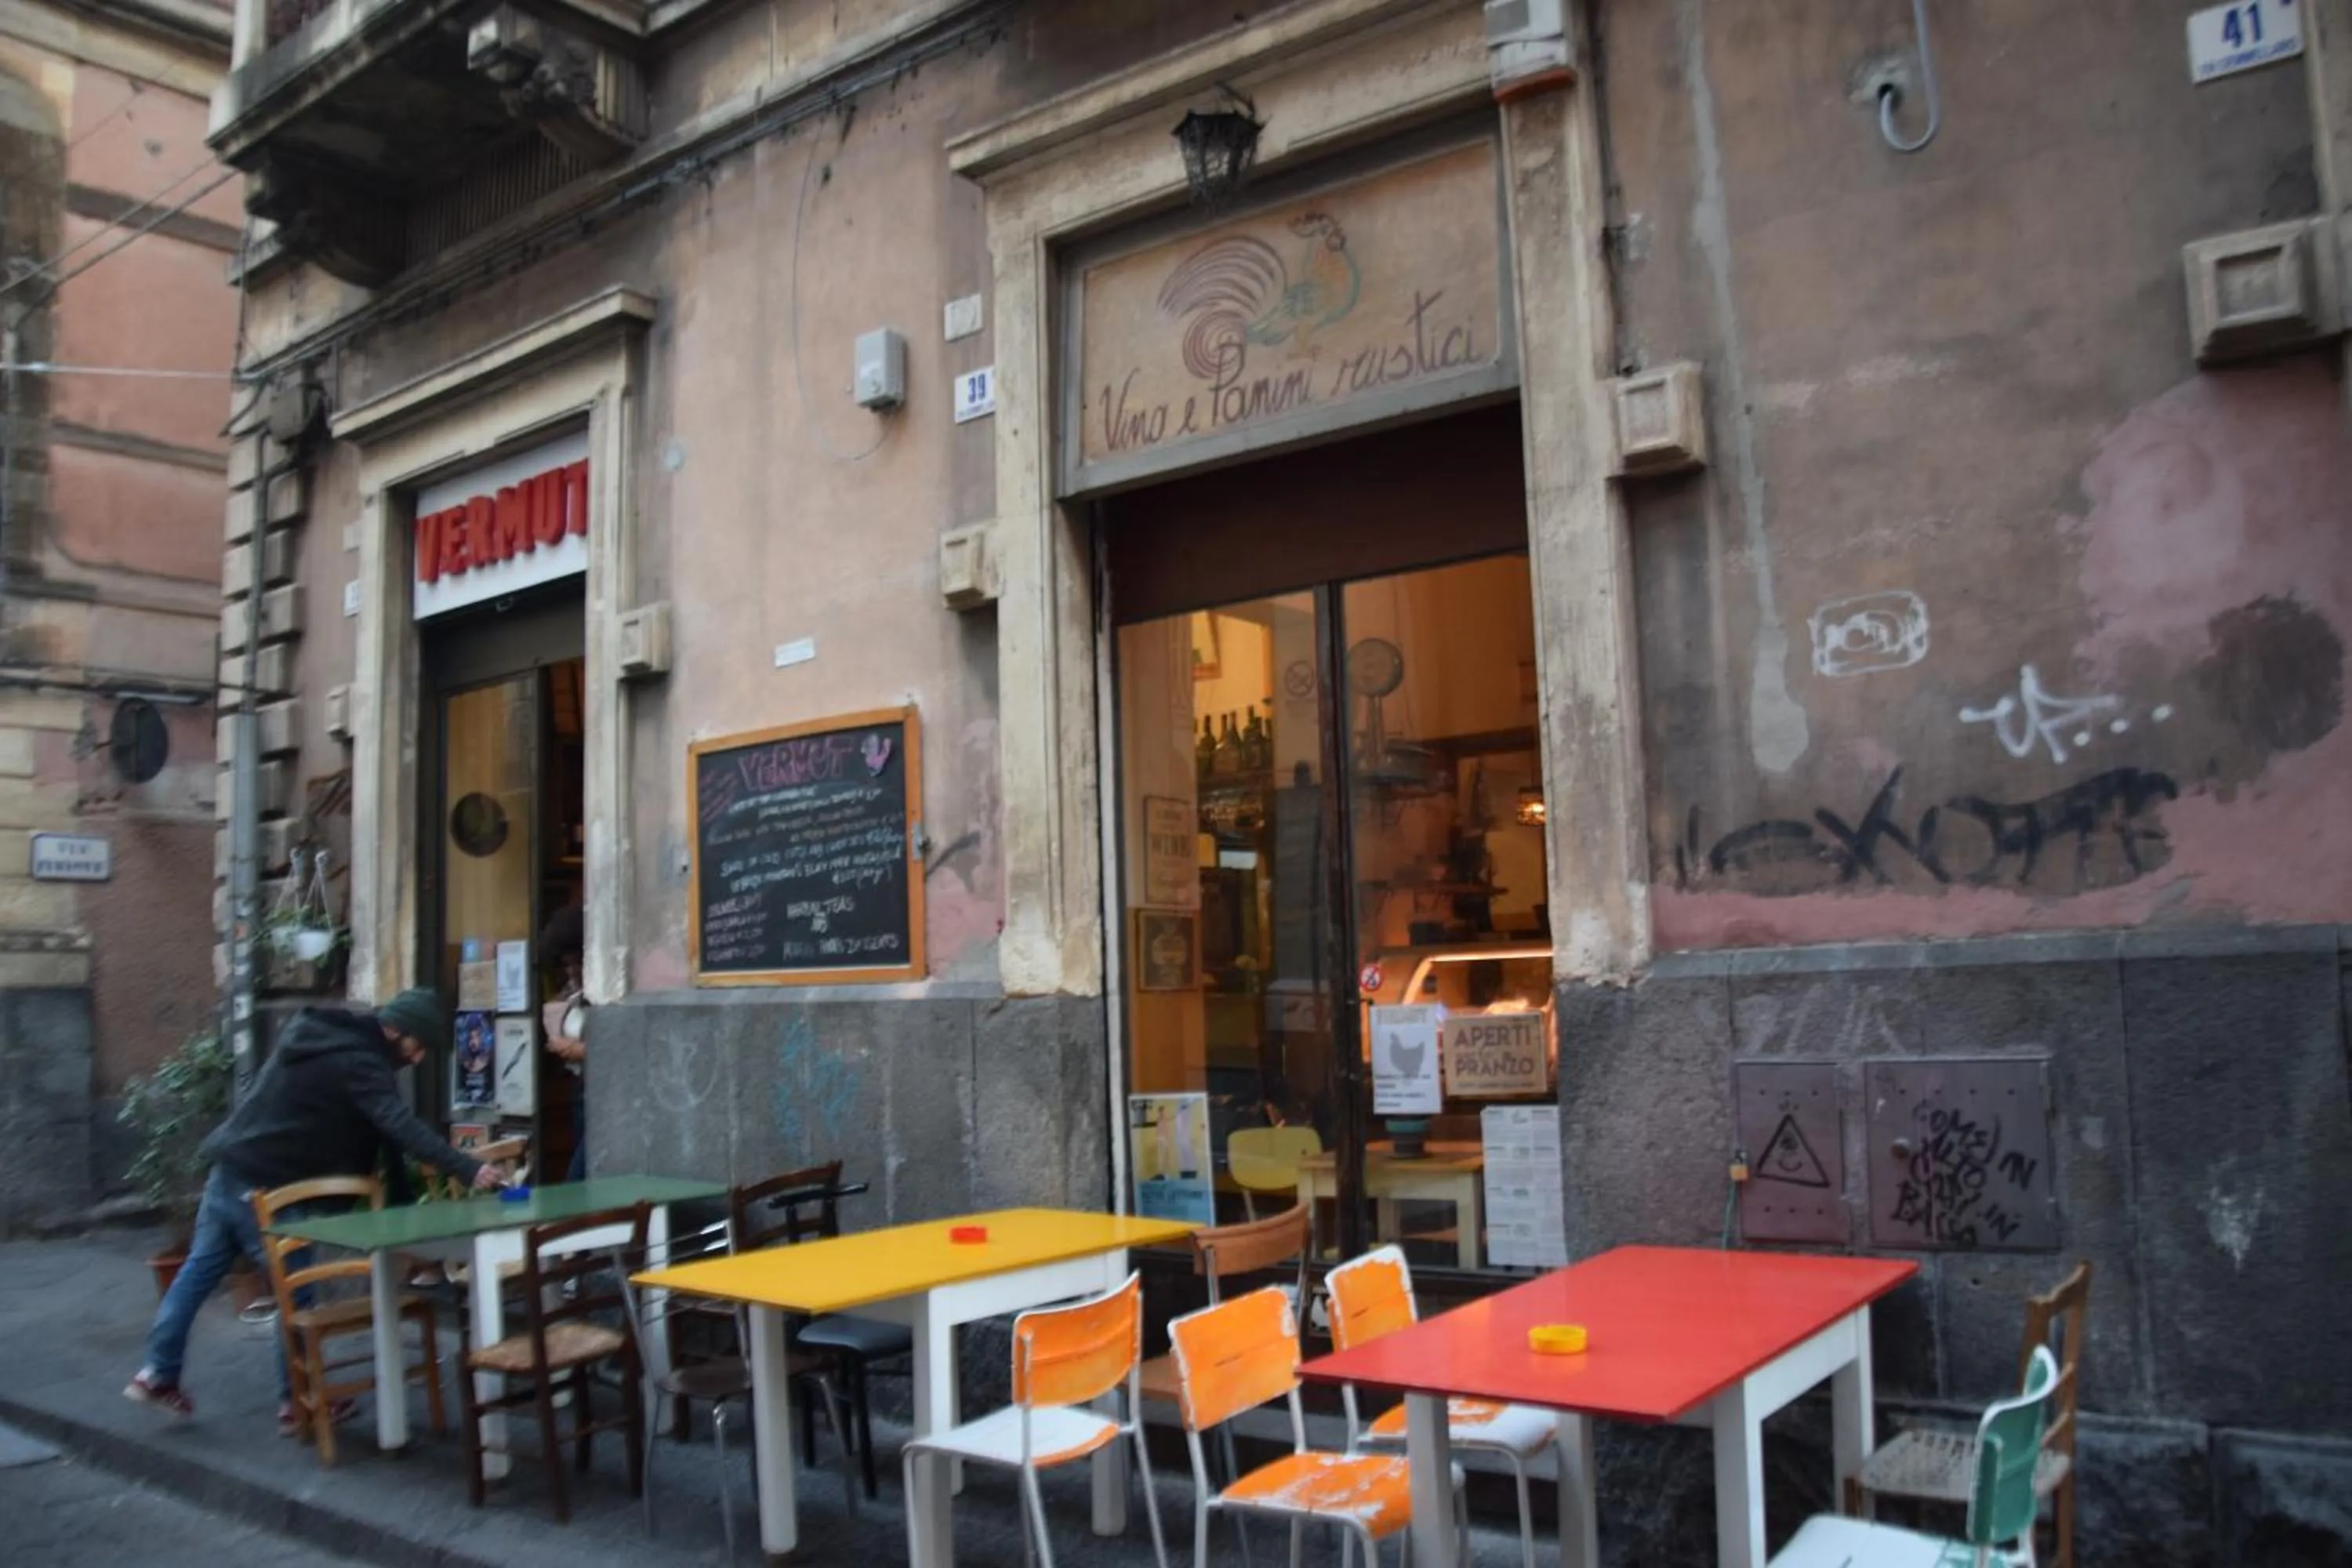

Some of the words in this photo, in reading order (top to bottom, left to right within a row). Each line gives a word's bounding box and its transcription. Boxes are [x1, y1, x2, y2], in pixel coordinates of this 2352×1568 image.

[2222, 1, 2263, 48] 41
[968, 373, 985, 403] 39
[1099, 368, 1169, 452] Vino
[1208, 342, 1312, 428] Panini
[416, 457, 589, 582] VERMUT
[1454, 1024, 1531, 1047] APERTI
[1455, 1055, 1534, 1078] PRANZO
